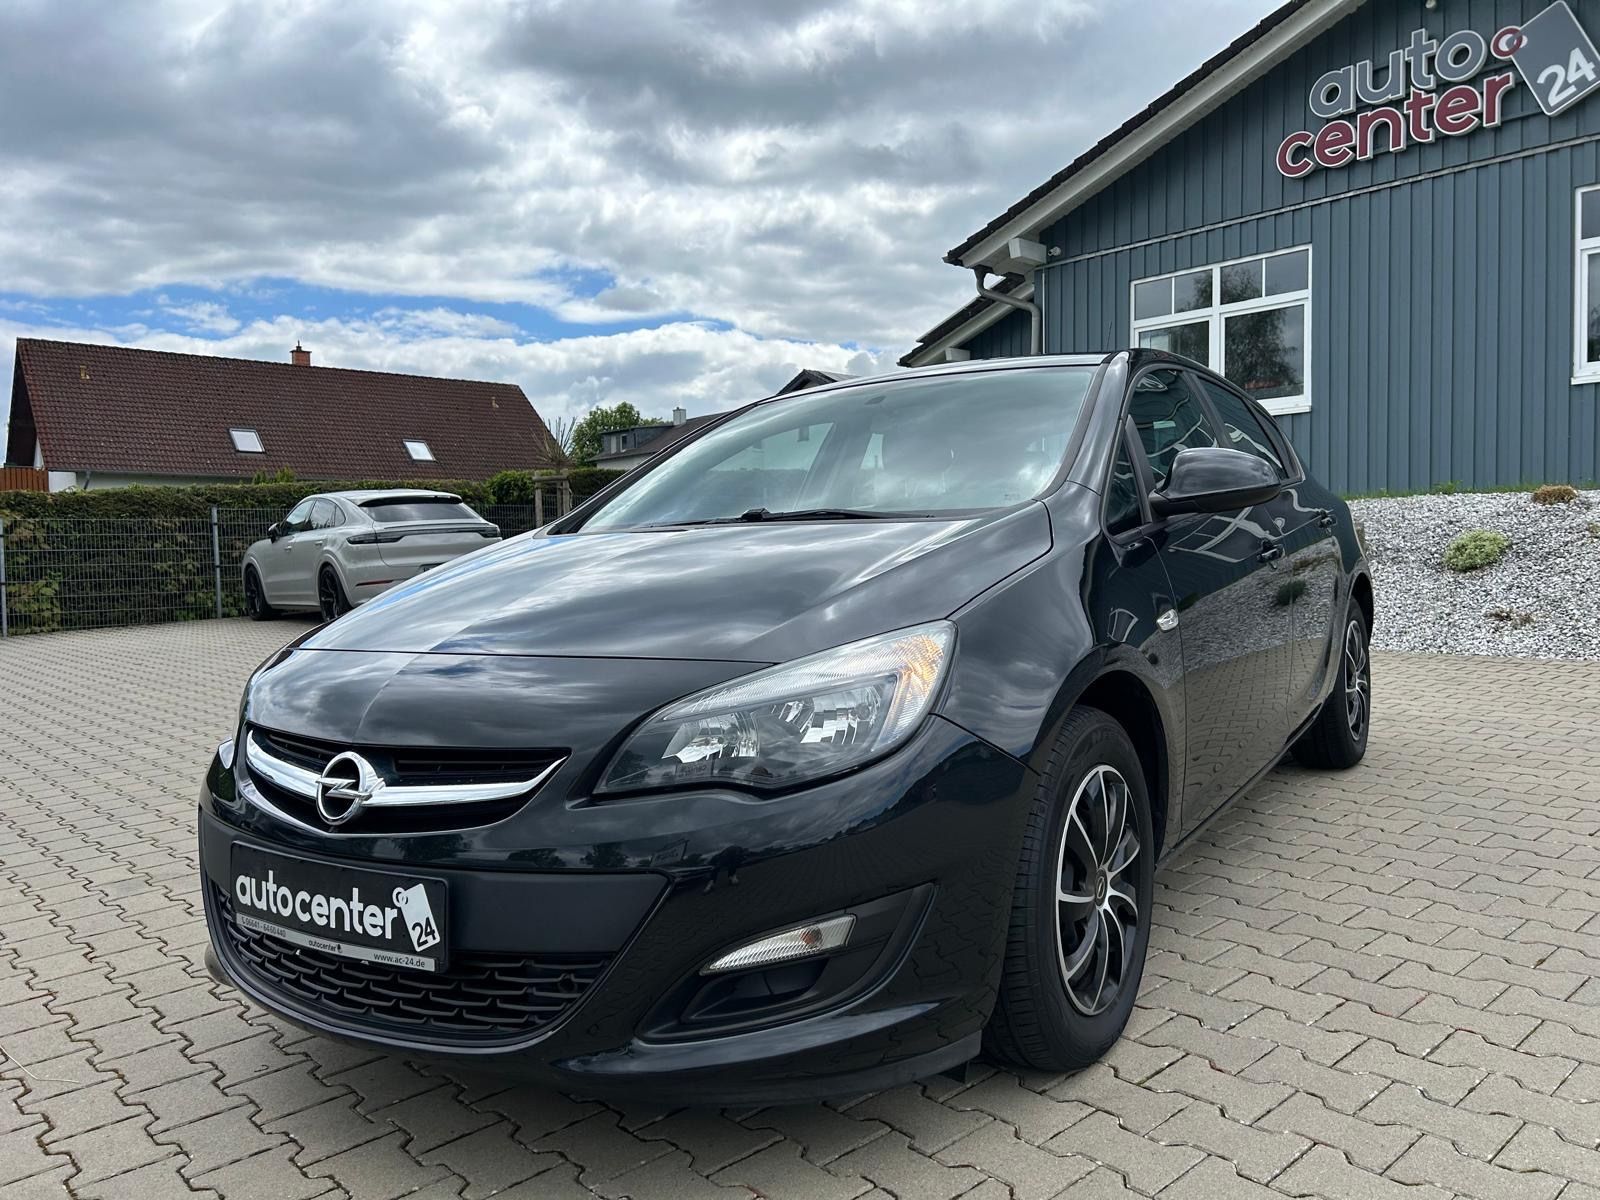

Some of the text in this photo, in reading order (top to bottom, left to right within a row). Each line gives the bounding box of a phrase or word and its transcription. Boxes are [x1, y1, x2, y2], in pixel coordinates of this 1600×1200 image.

[1309, 28, 1487, 118] auto
[1537, 47, 1596, 106] 24
[1276, 71, 1514, 178] center
[236, 870, 437, 947] autocenter 24
[308, 939, 336, 952] autocenter
[373, 953, 425, 968] www.ac-24.de
